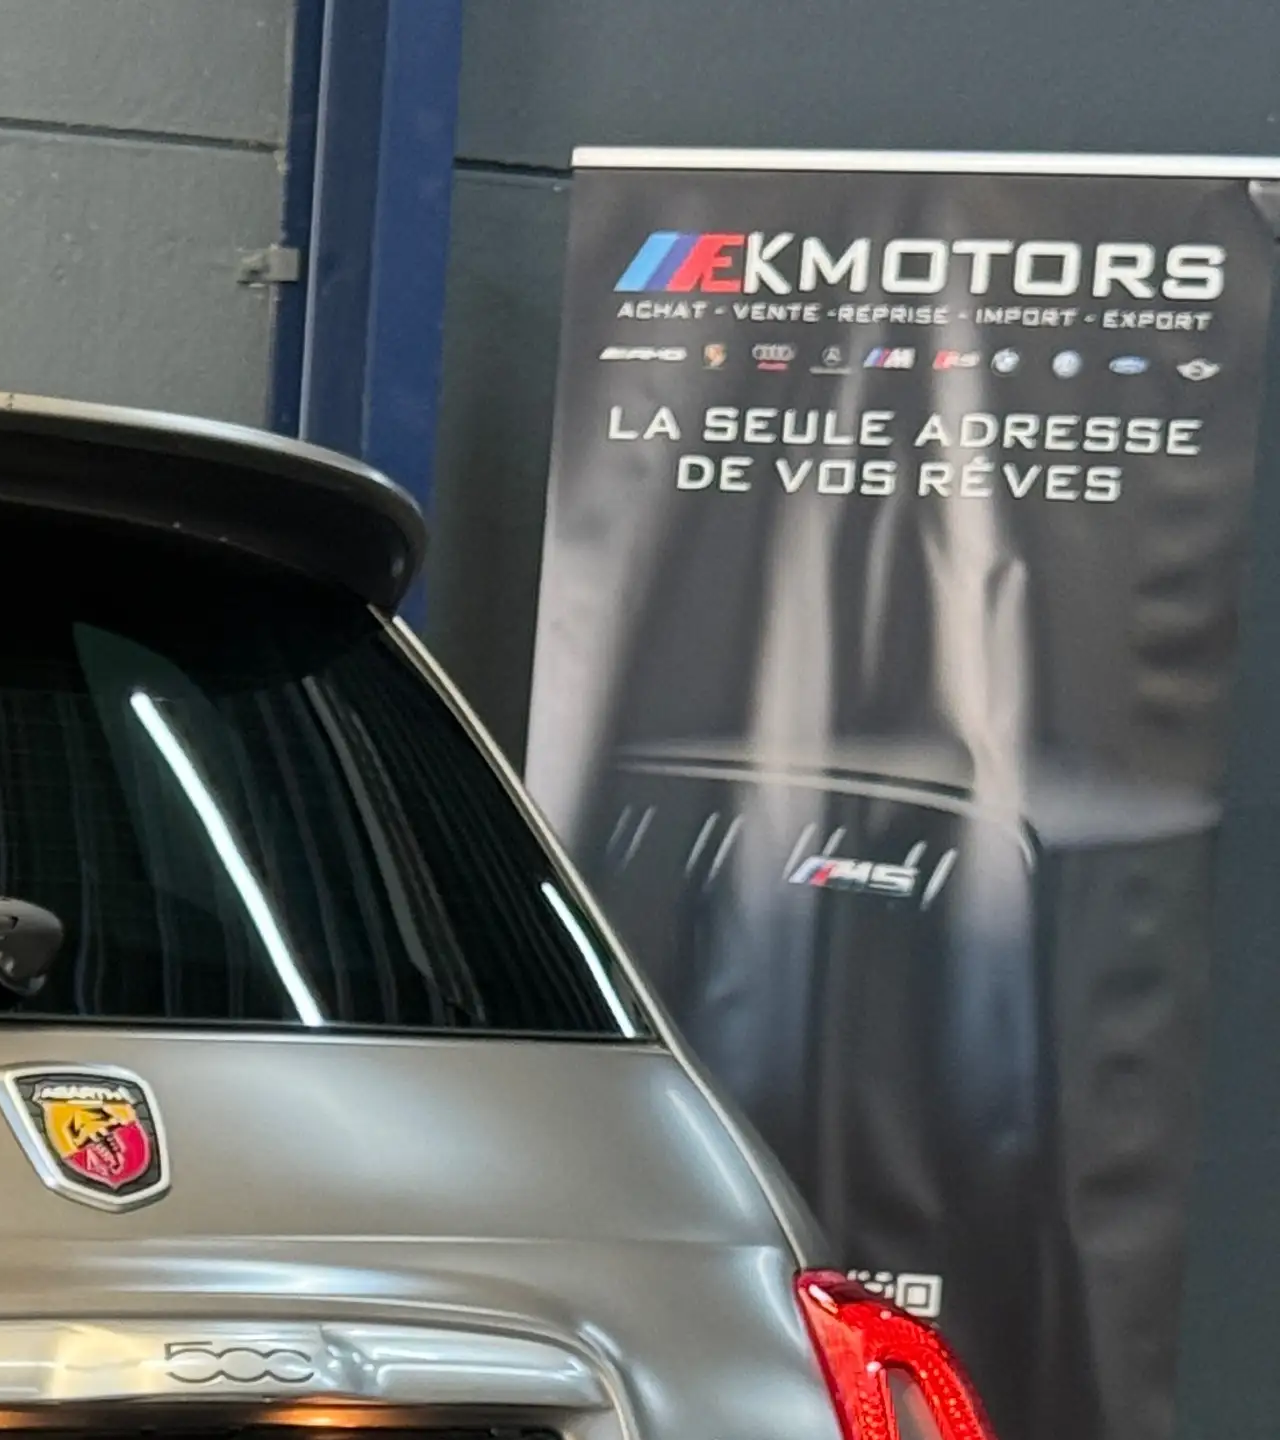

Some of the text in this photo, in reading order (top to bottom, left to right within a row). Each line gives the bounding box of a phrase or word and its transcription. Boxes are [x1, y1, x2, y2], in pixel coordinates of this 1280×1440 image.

[678, 231, 1227, 300] EKMOTORS
[616, 300, 709, 320] ACHAT
[732, 303, 820, 322] VENTE
[974, 307, 1079, 327] IMPORT
[1102, 309, 1212, 331] EXPORT
[608, 405, 1203, 455] LA SEULE ADRESSE
[676, 454, 754, 492] DE
[775, 458, 898, 495] VOS
[164, 1340, 315, 1384] 500
